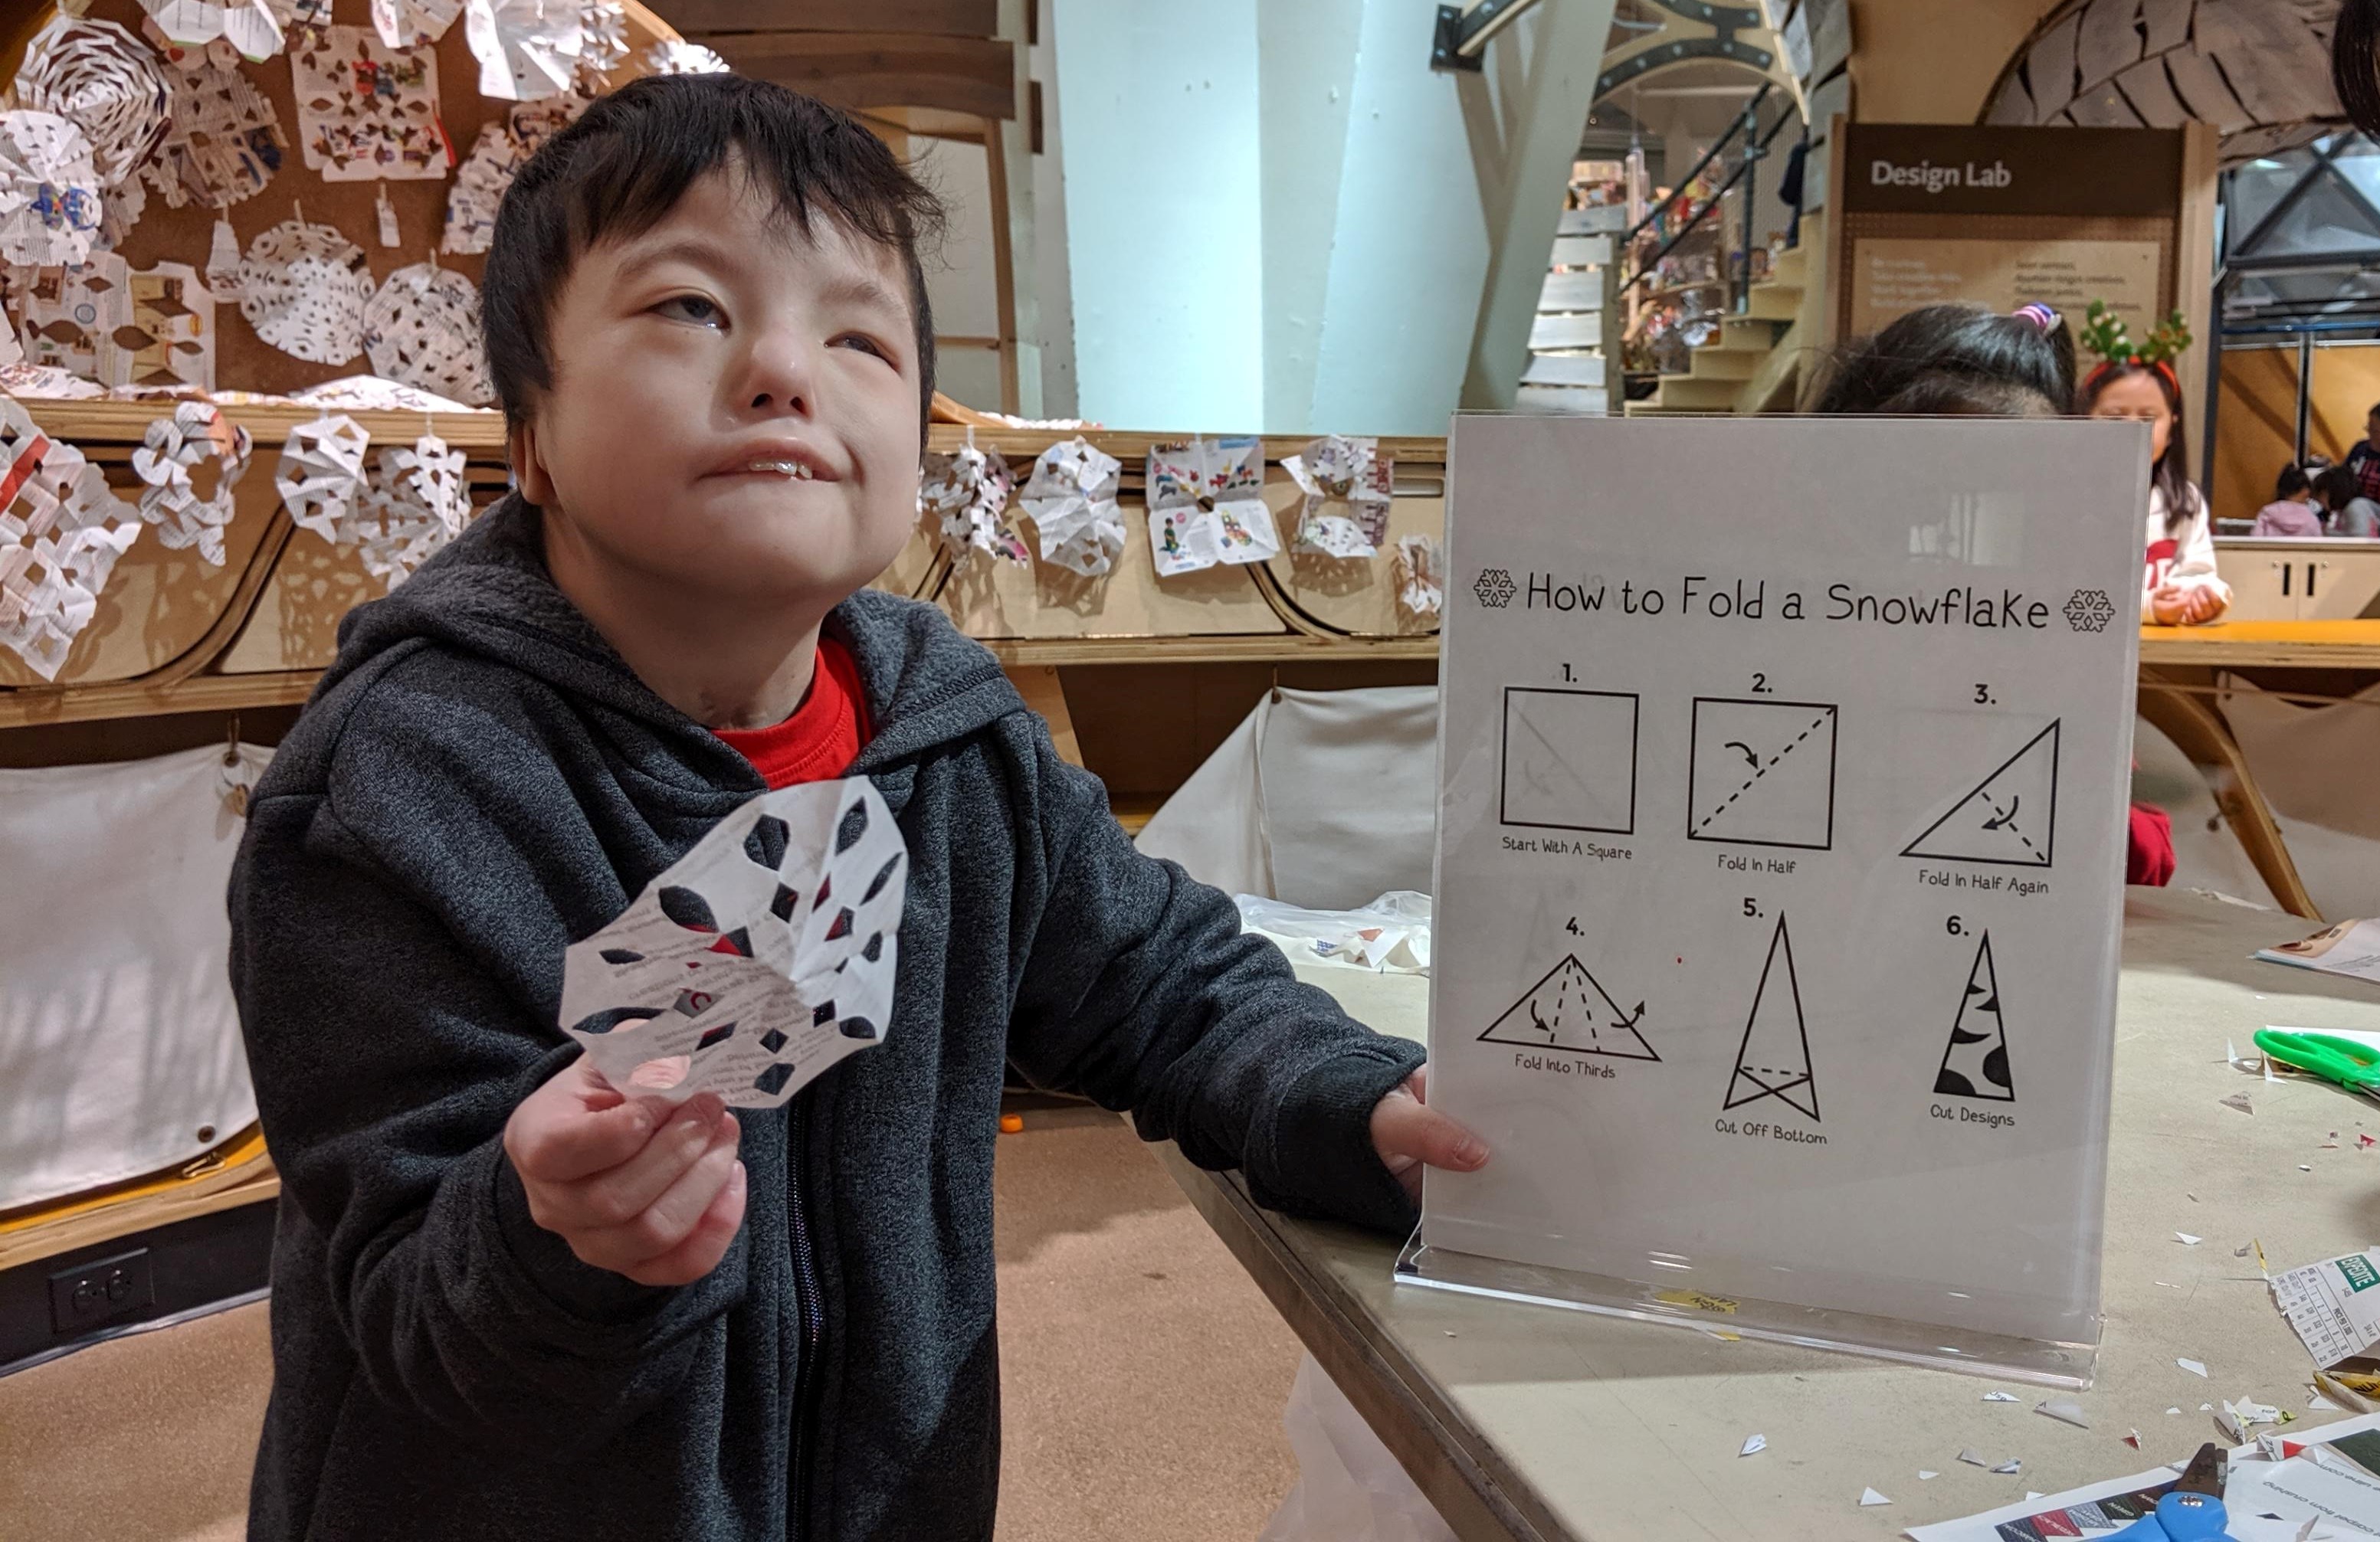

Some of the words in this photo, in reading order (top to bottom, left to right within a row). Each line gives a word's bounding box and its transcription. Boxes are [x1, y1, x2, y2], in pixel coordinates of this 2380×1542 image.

[1871, 160, 1959, 192] Design
[1965, 162, 2011, 188] Lab
[1527, 571, 1605, 612] How
[1621, 579, 1664, 615] to
[1682, 575, 1765, 620] Fold
[1781, 592, 1806, 620] a
[1825, 583, 2050, 630] Snowflake
[1562, 663, 1578, 683] 1.
[1751, 672, 1773, 694] 2.
[1973, 683, 1997, 706] 3.
[1502, 836, 1538, 853] Start
[1542, 838, 1569, 854] With
[1572, 841, 1583, 856] A
[1586, 843, 1633, 862] Square
[1717, 853, 1747, 872] Fold
[1752, 858, 1763, 872] In
[1767, 859, 1797, 874] Half
[1919, 869, 1950, 887] Fold
[1955, 872, 1967, 888] In
[1972, 874, 2003, 890] Half
[2007, 876, 2049, 897] Again
[1742, 896, 1764, 918] 5.
[1565, 916, 1585, 937] 4.
[1946, 915, 1970, 937] 6.
[1515, 1053, 1542, 1071] Fold
[1546, 1058, 1571, 1074] Into
[1575, 1060, 1616, 1079] Thirds
[1929, 1103, 1955, 1121] Cut
[1960, 1106, 2015, 1129] Designs
[1714, 1118, 1738, 1134] Cut
[1742, 1121, 1769, 1138] Off
[1773, 1125, 1828, 1144] Bottom
